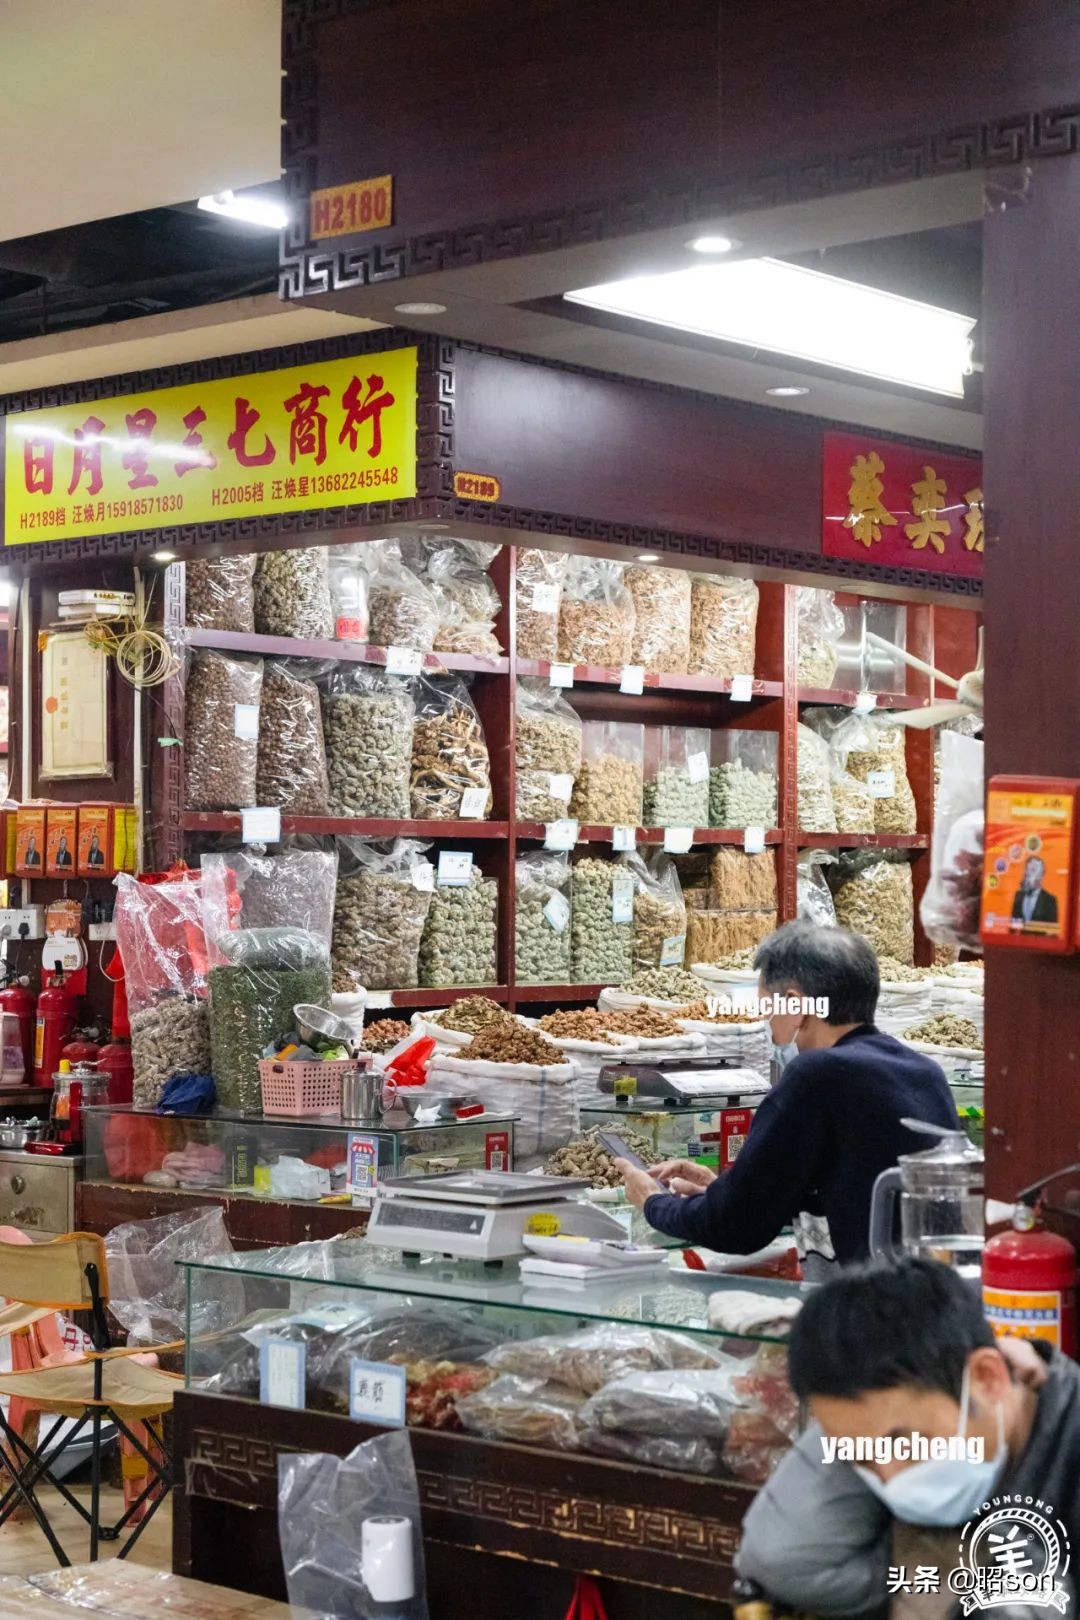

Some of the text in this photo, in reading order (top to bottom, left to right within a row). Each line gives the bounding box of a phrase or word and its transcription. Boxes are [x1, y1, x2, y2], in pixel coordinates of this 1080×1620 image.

[314, 189, 385, 232] H2180
[23, 374, 395, 496] 日月星三七商行
[212, 467, 399, 506] H2005档 汪焕星13682245548
[20, 494, 183, 529] H2189档 汪焕月15918571830
